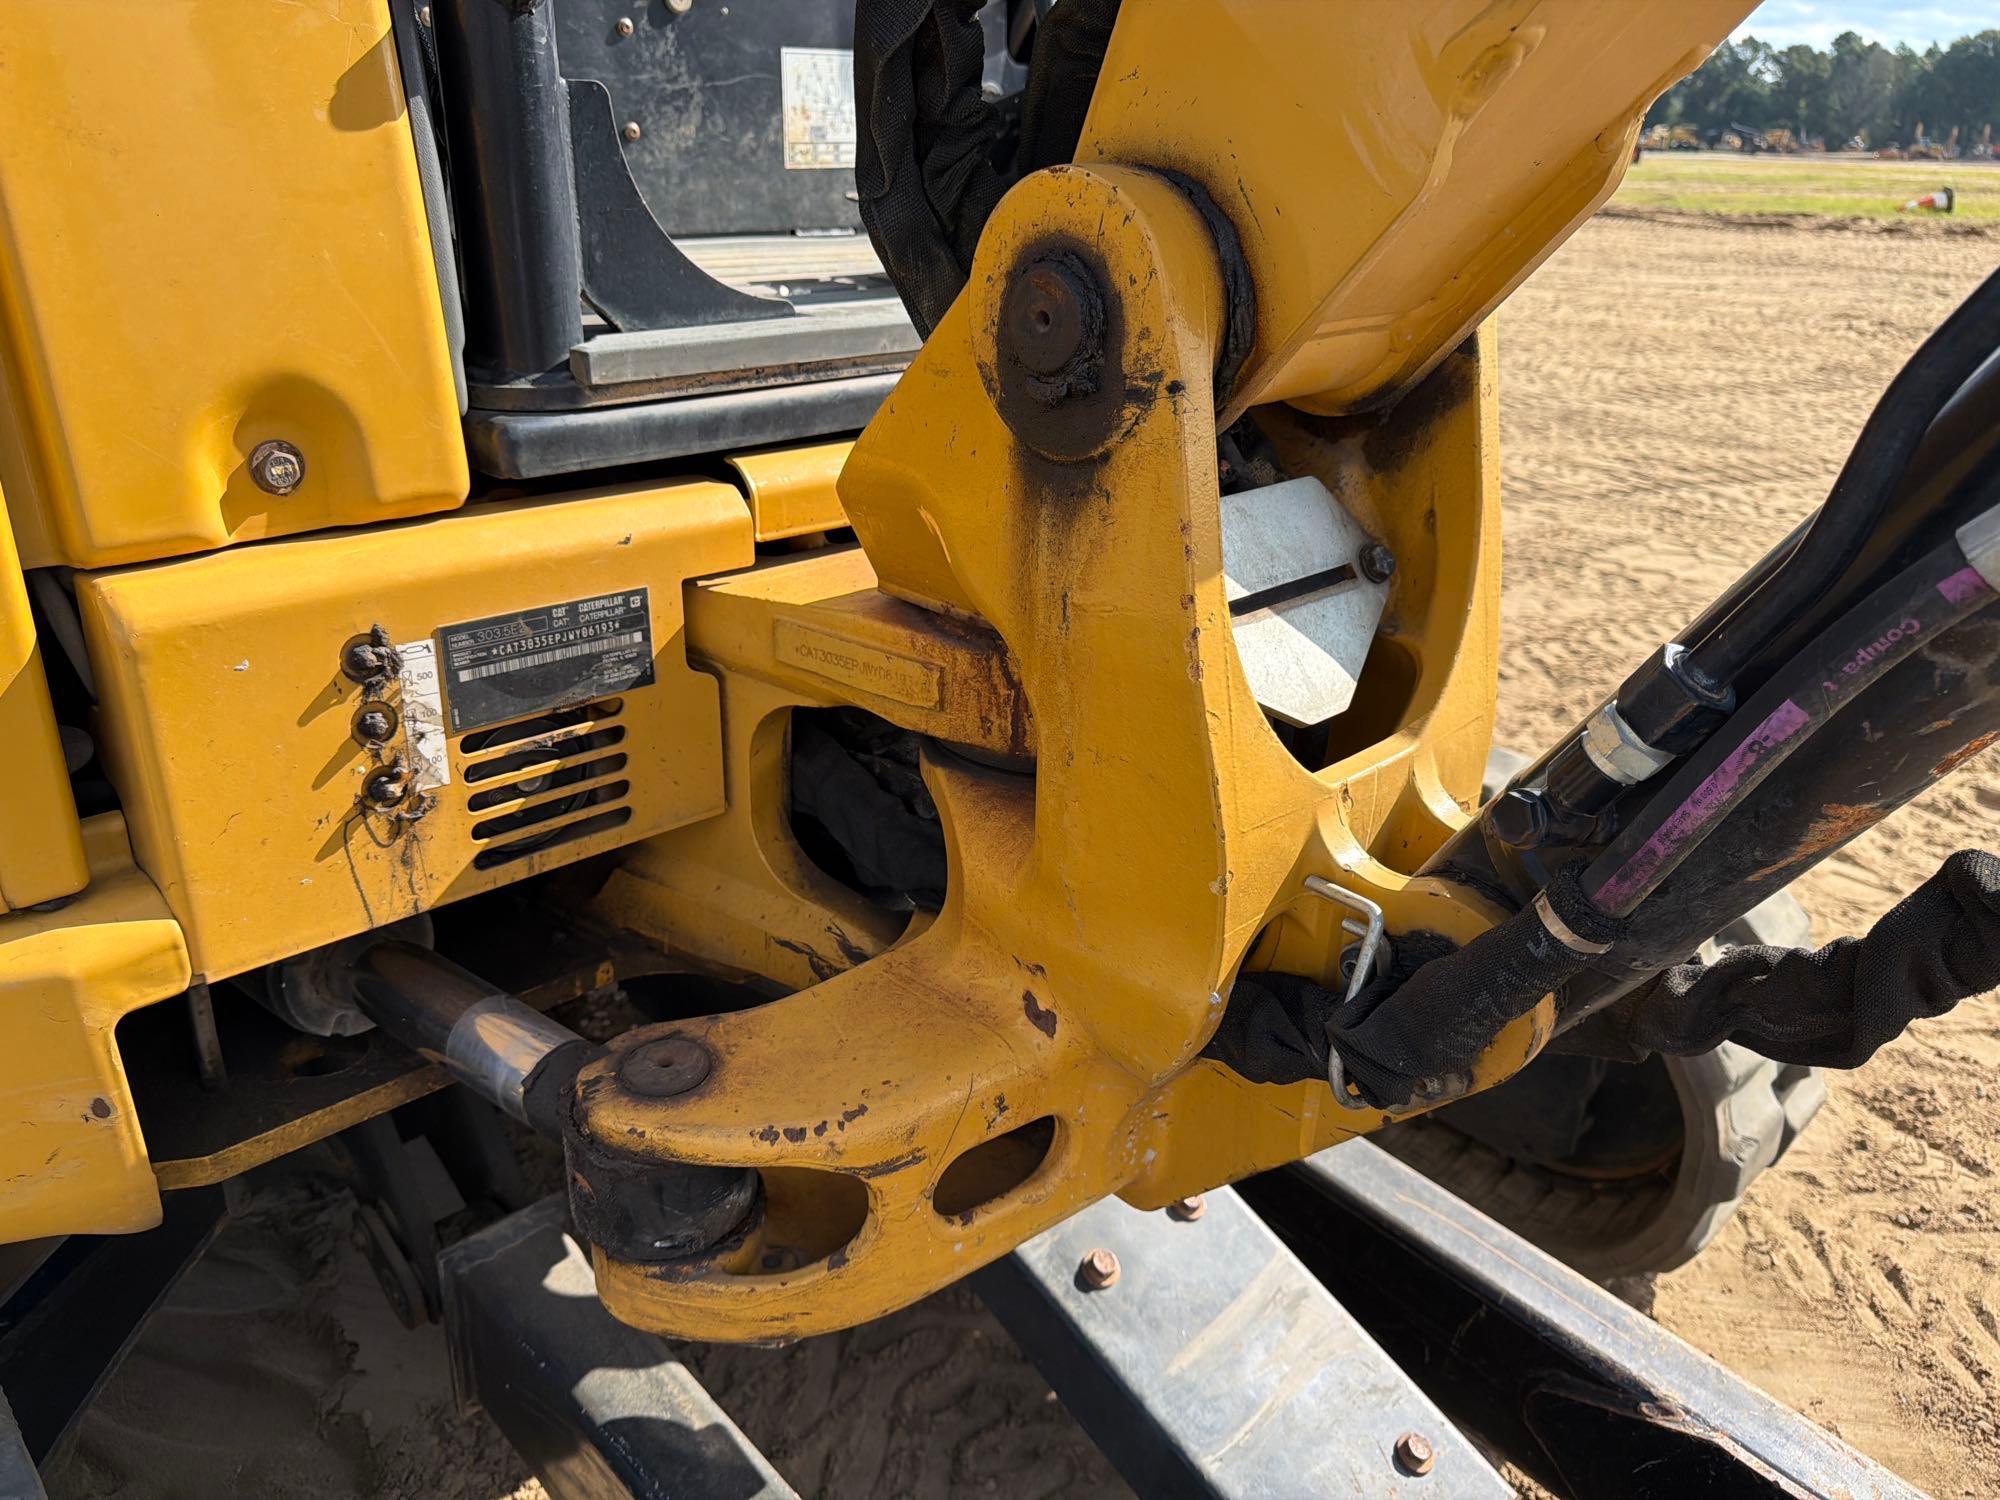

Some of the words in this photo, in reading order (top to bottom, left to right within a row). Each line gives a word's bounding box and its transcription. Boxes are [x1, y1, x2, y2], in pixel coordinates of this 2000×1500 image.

[552, 606, 568, 618] CAT
[579, 596, 624, 613] CATERPILLAR
[553, 618, 569, 628] CAT
[580, 607, 626, 623] CATERPILLAR
[416, 670, 433, 681] 500
[421, 708, 437, 719] 100
